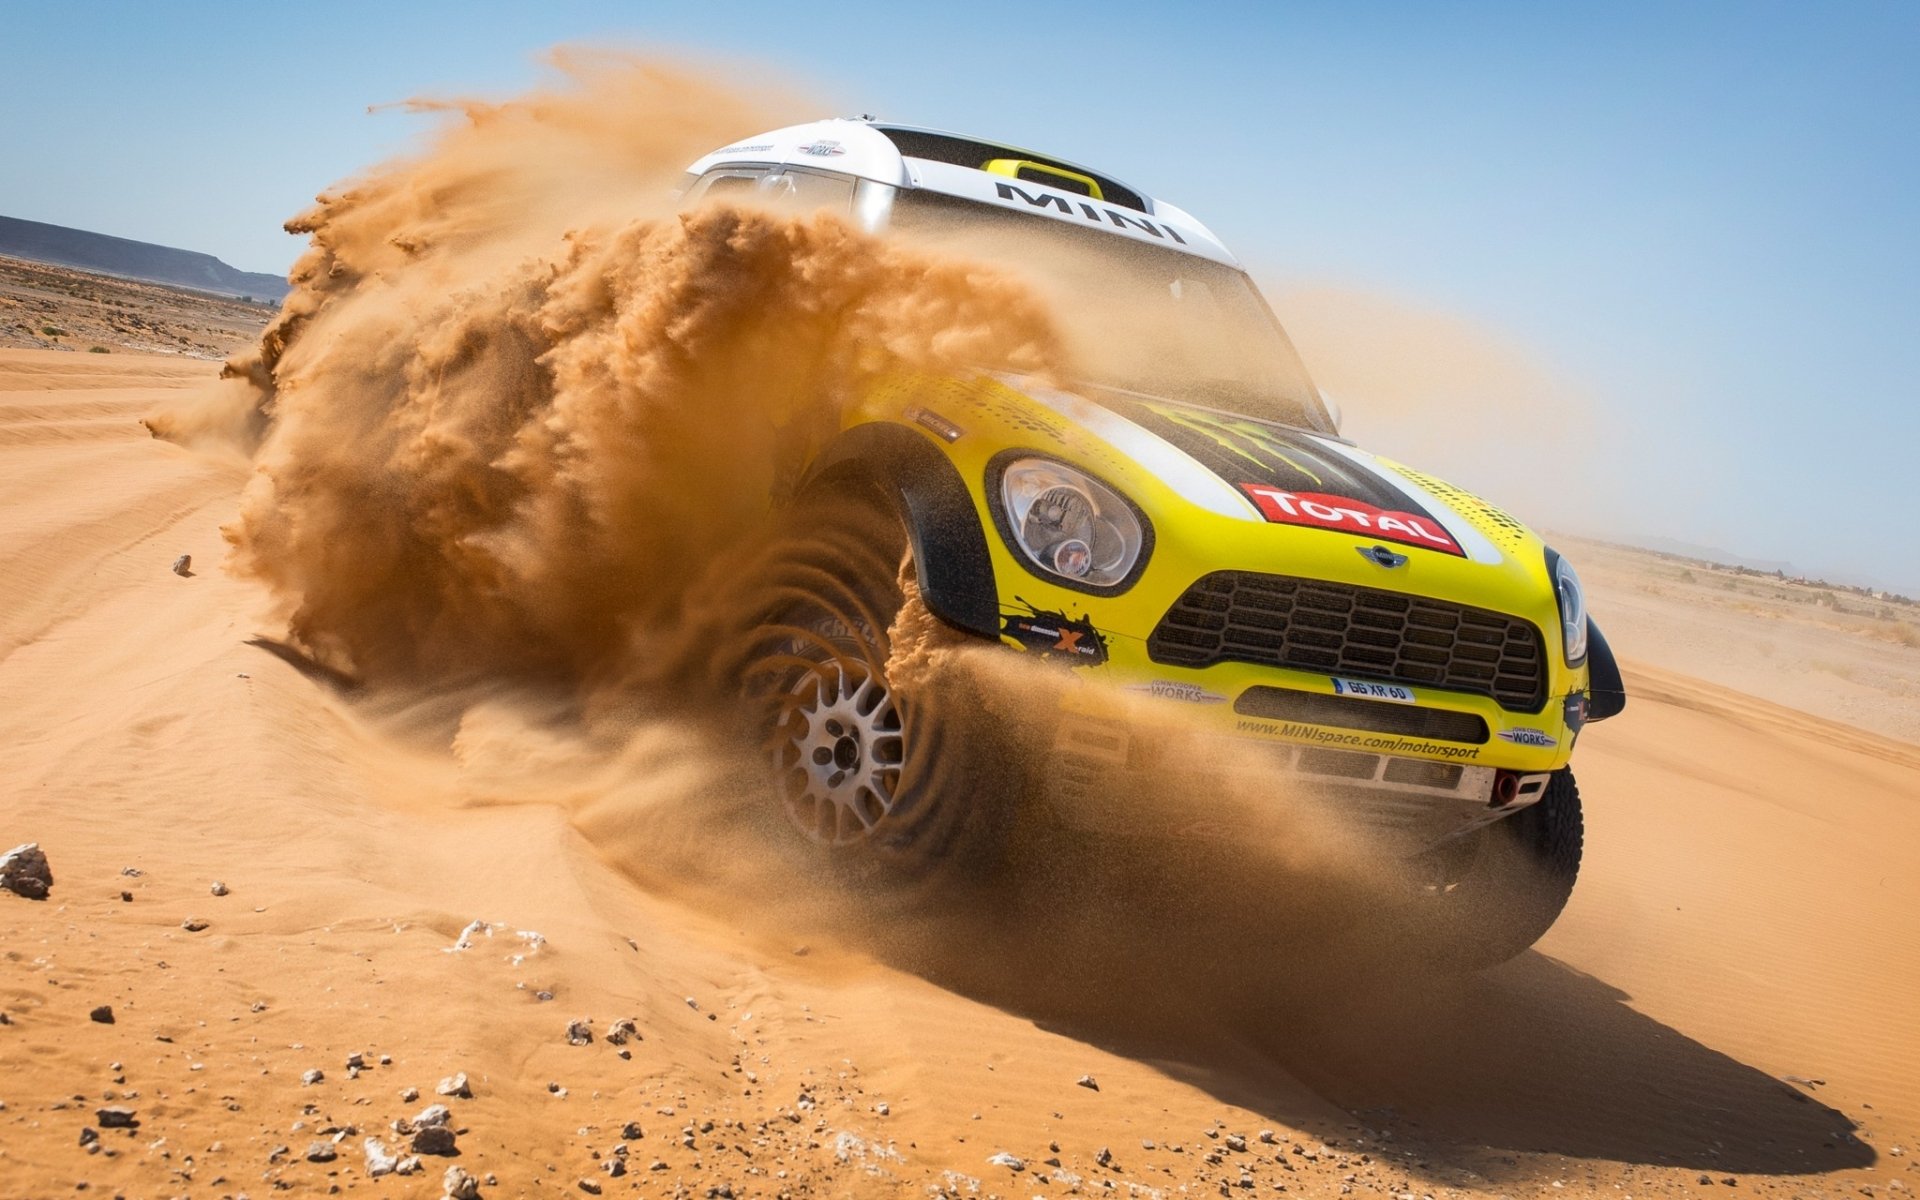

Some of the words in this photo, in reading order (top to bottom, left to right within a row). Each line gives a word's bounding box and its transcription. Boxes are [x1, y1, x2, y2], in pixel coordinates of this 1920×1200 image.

[995, 182, 1187, 245] MINI
[1253, 489, 1451, 545] TOTAL
[1151, 686, 1202, 702] WORKS
[1348, 682, 1368, 694] GG
[1369, 684, 1388, 697] XR
[1389, 687, 1407, 699] 60
[1236, 720, 1480, 760] www.MINIspace.com/motorsport
[1512, 732, 1546, 746] WORKS
